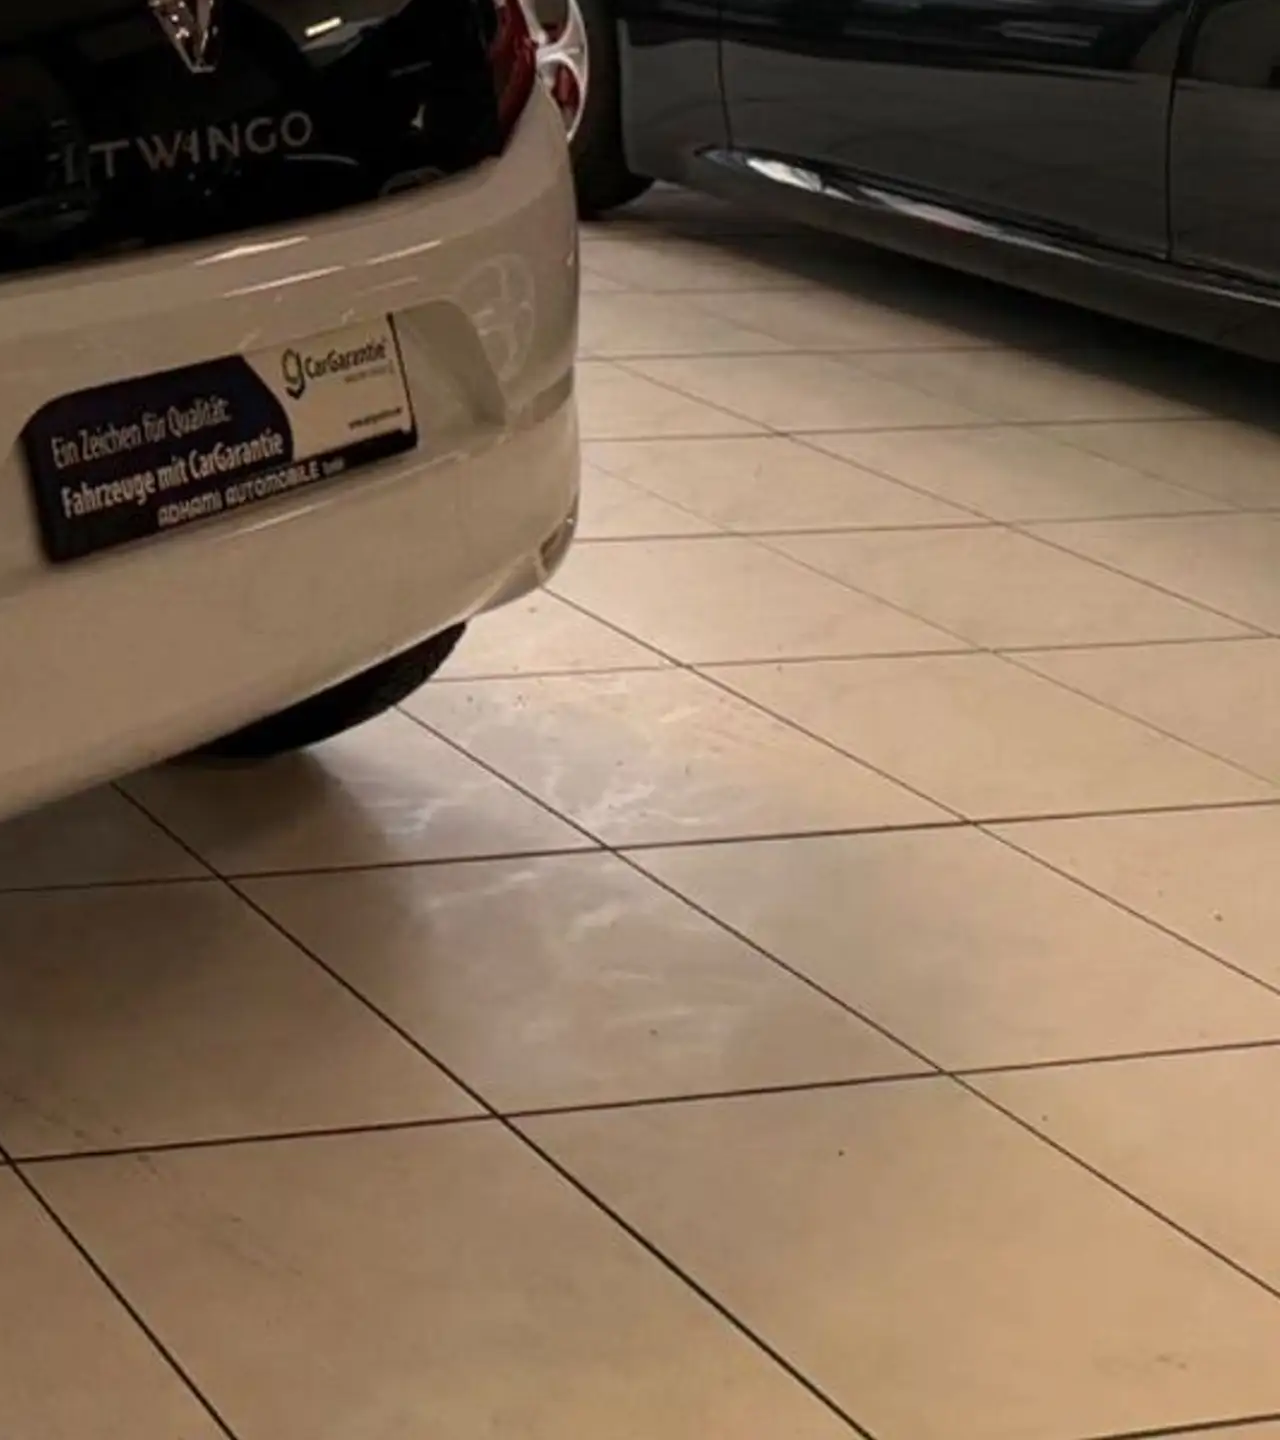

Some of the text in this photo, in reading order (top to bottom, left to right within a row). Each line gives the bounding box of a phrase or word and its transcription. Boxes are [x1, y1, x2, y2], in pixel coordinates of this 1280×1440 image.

[88, 110, 313, 179] TWINGO
[51, 436, 80, 470] Ein
[79, 422, 142, 461] Zeichen
[142, 411, 167, 443] für
[60, 427, 286, 520] Fahrzeuge mit CarGarantie
